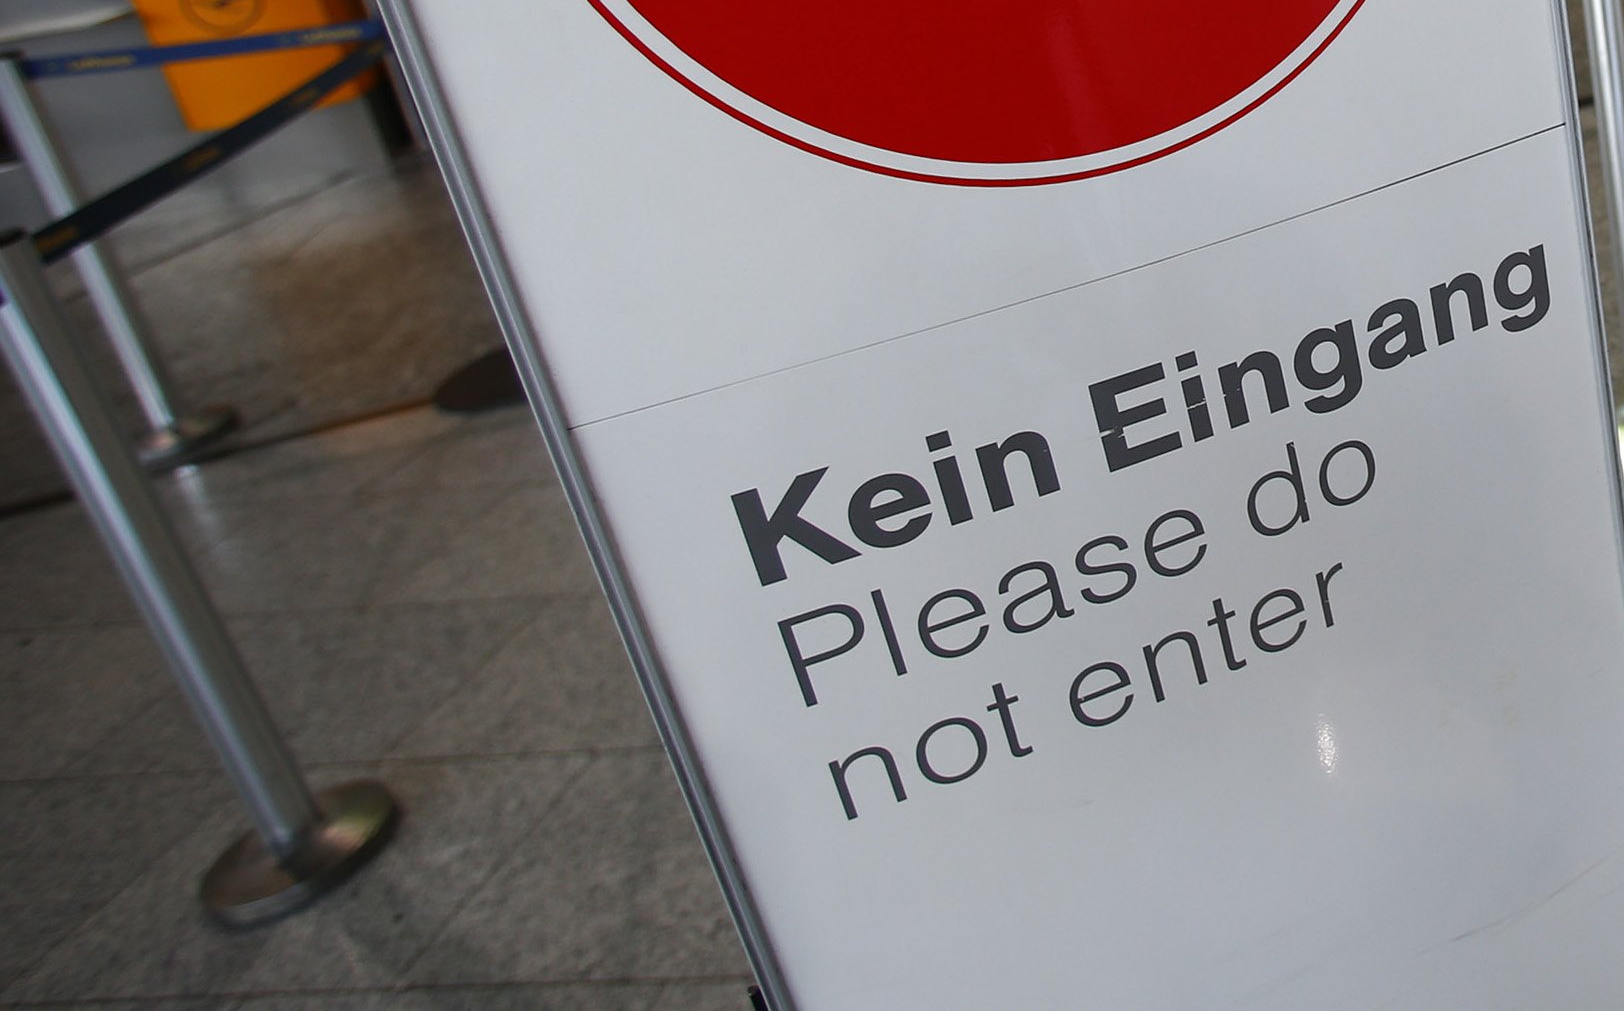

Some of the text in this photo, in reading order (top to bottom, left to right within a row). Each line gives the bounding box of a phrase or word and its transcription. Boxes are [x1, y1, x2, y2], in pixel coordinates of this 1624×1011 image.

[731, 243, 1551, 587] Kein Eingang
[777, 440, 1376, 708] Please do
[828, 562, 1343, 821] not enter
